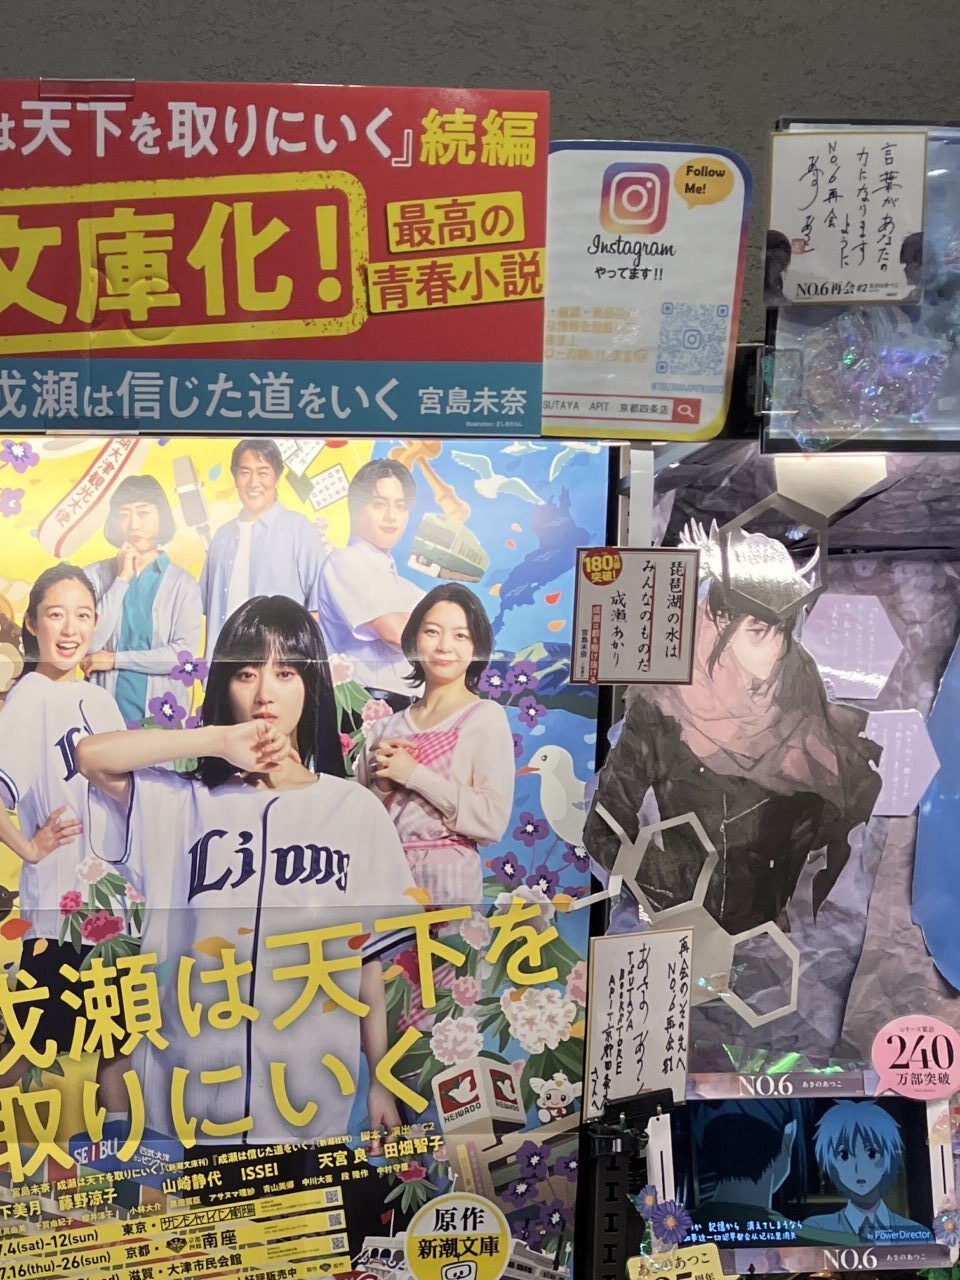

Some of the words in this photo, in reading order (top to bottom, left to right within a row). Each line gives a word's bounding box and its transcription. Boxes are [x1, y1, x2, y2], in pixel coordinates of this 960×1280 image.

[685, 165, 726, 178] Follow
[684, 182, 707, 195] Me!
[393, 199, 515, 249] 最高の
[587, 235, 677, 267] Instagram
[372, 250, 543, 310] 青春小説
[418, 386, 527, 416] 宮島未奈
[589, 402, 610, 412] APIT
[637, 560, 656, 673] みんなのものだ
[665, 561, 684, 659] 琵琶湖の水は
[887, 1034, 954, 1072] 240
[738, 1075, 794, 1097] NO.6
[896, 1072, 951, 1087] 万部突破
[58, 1188, 118, 1211] 藤野涼子
[240, 1161, 279, 1182] ISSEI
[383, 1135, 444, 1159] 田畑智子
[434, 1207, 485, 1232] 原作
[201, 1228, 239, 1250] 南座
[874, 1229, 931, 1241] PowerDirector
[417, 1236, 500, 1260] 新潮文庫
[823, 1247, 878, 1271] NO.6
